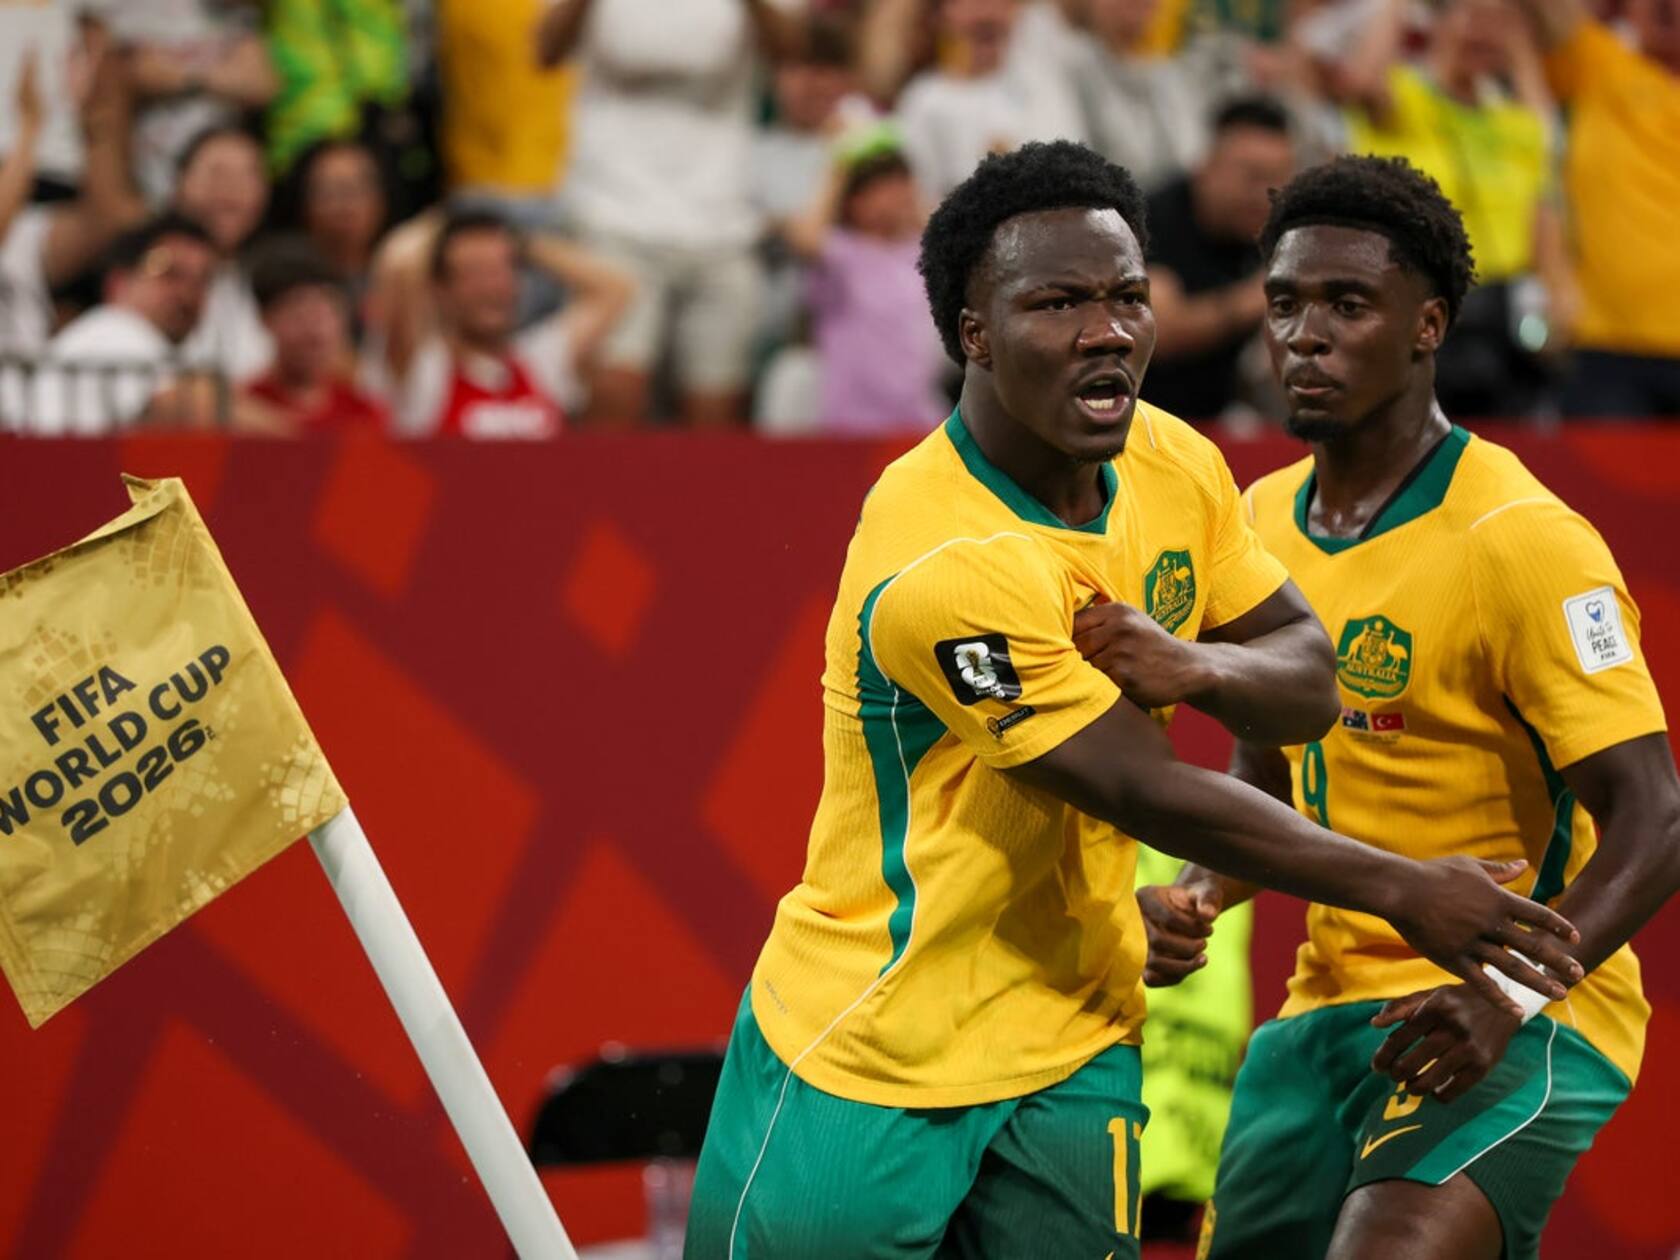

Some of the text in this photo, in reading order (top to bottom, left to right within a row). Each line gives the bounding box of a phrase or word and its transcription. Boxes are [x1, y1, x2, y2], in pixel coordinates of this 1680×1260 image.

[0, 645, 230, 835] WORLD CUP
[30, 664, 137, 746] FIFA
[61, 718, 206, 846] 2026
[1302, 741, 1332, 830] 9
